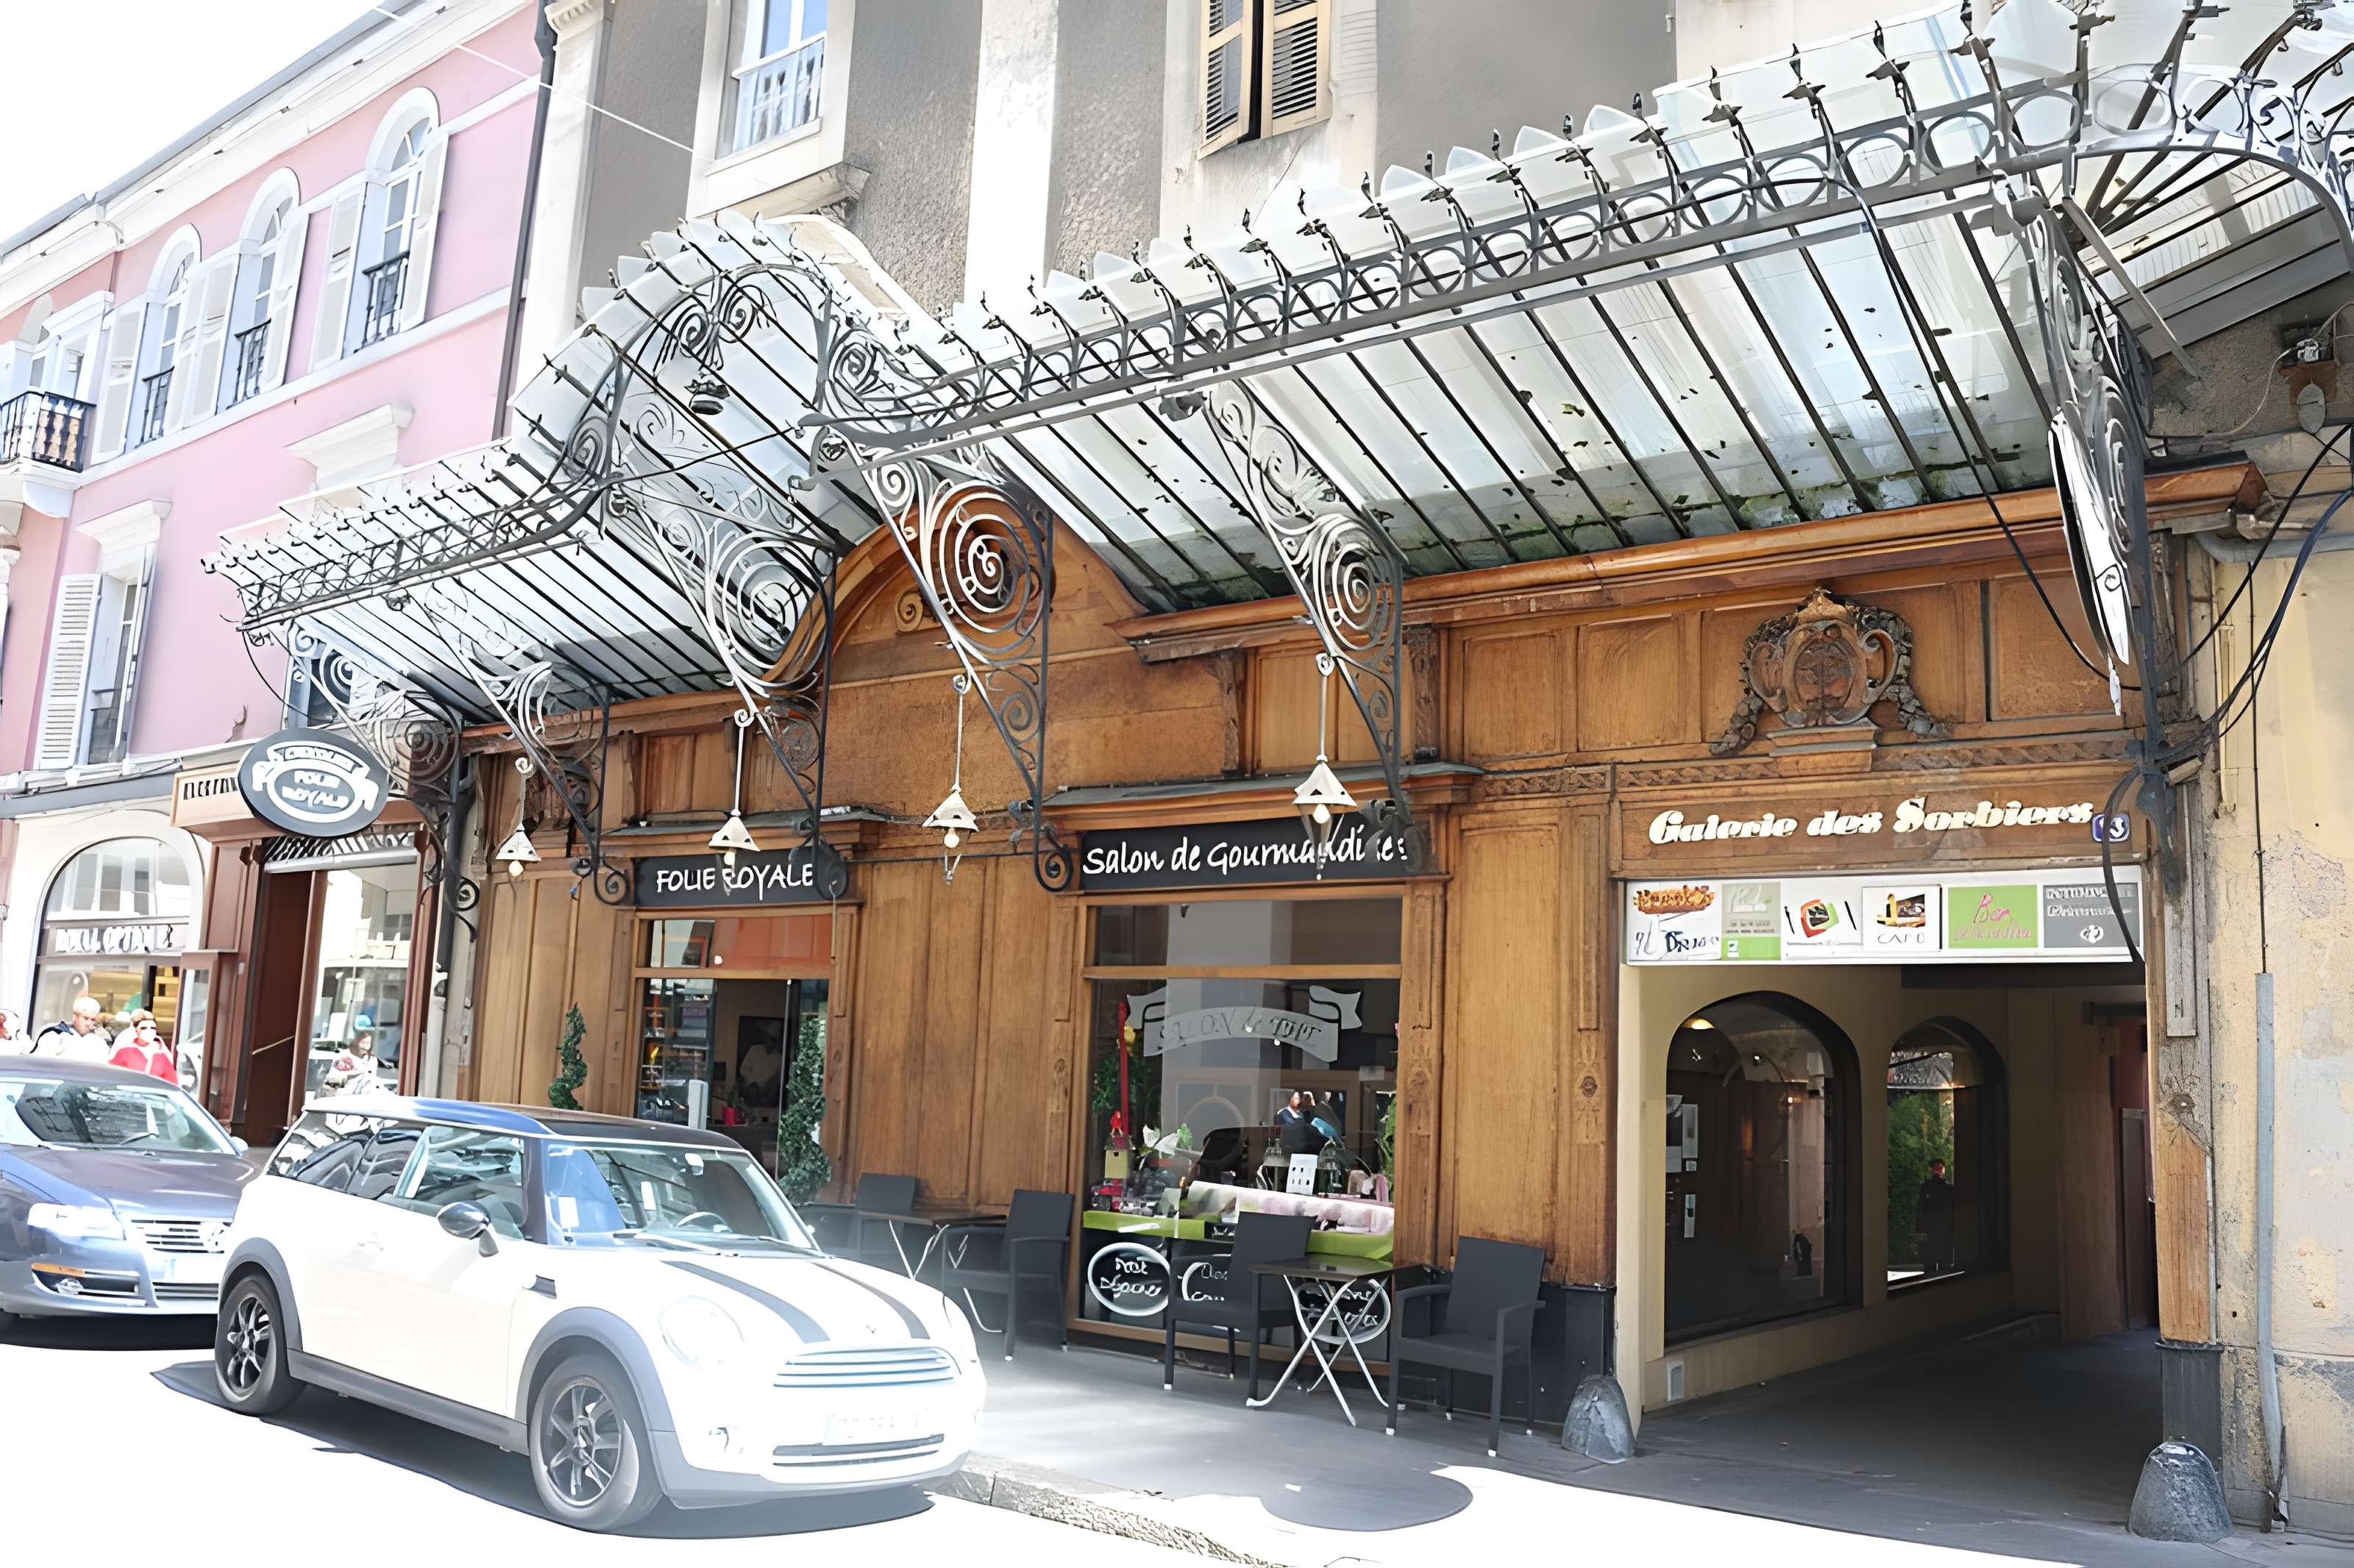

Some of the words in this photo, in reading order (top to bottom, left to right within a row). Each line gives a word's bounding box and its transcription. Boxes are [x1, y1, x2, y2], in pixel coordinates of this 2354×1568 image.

[1649, 810, 1797, 844] Galerie
[1807, 810, 1882, 836] des
[1893, 795, 2094, 833] Sorbiers
[1083, 841, 1164, 874] Salon
[1171, 836, 1201, 871] de
[1207, 824, 1408, 875] Gourmandies
[656, 867, 716, 893] FOLIE
[722, 863, 813, 901] ROYALE
